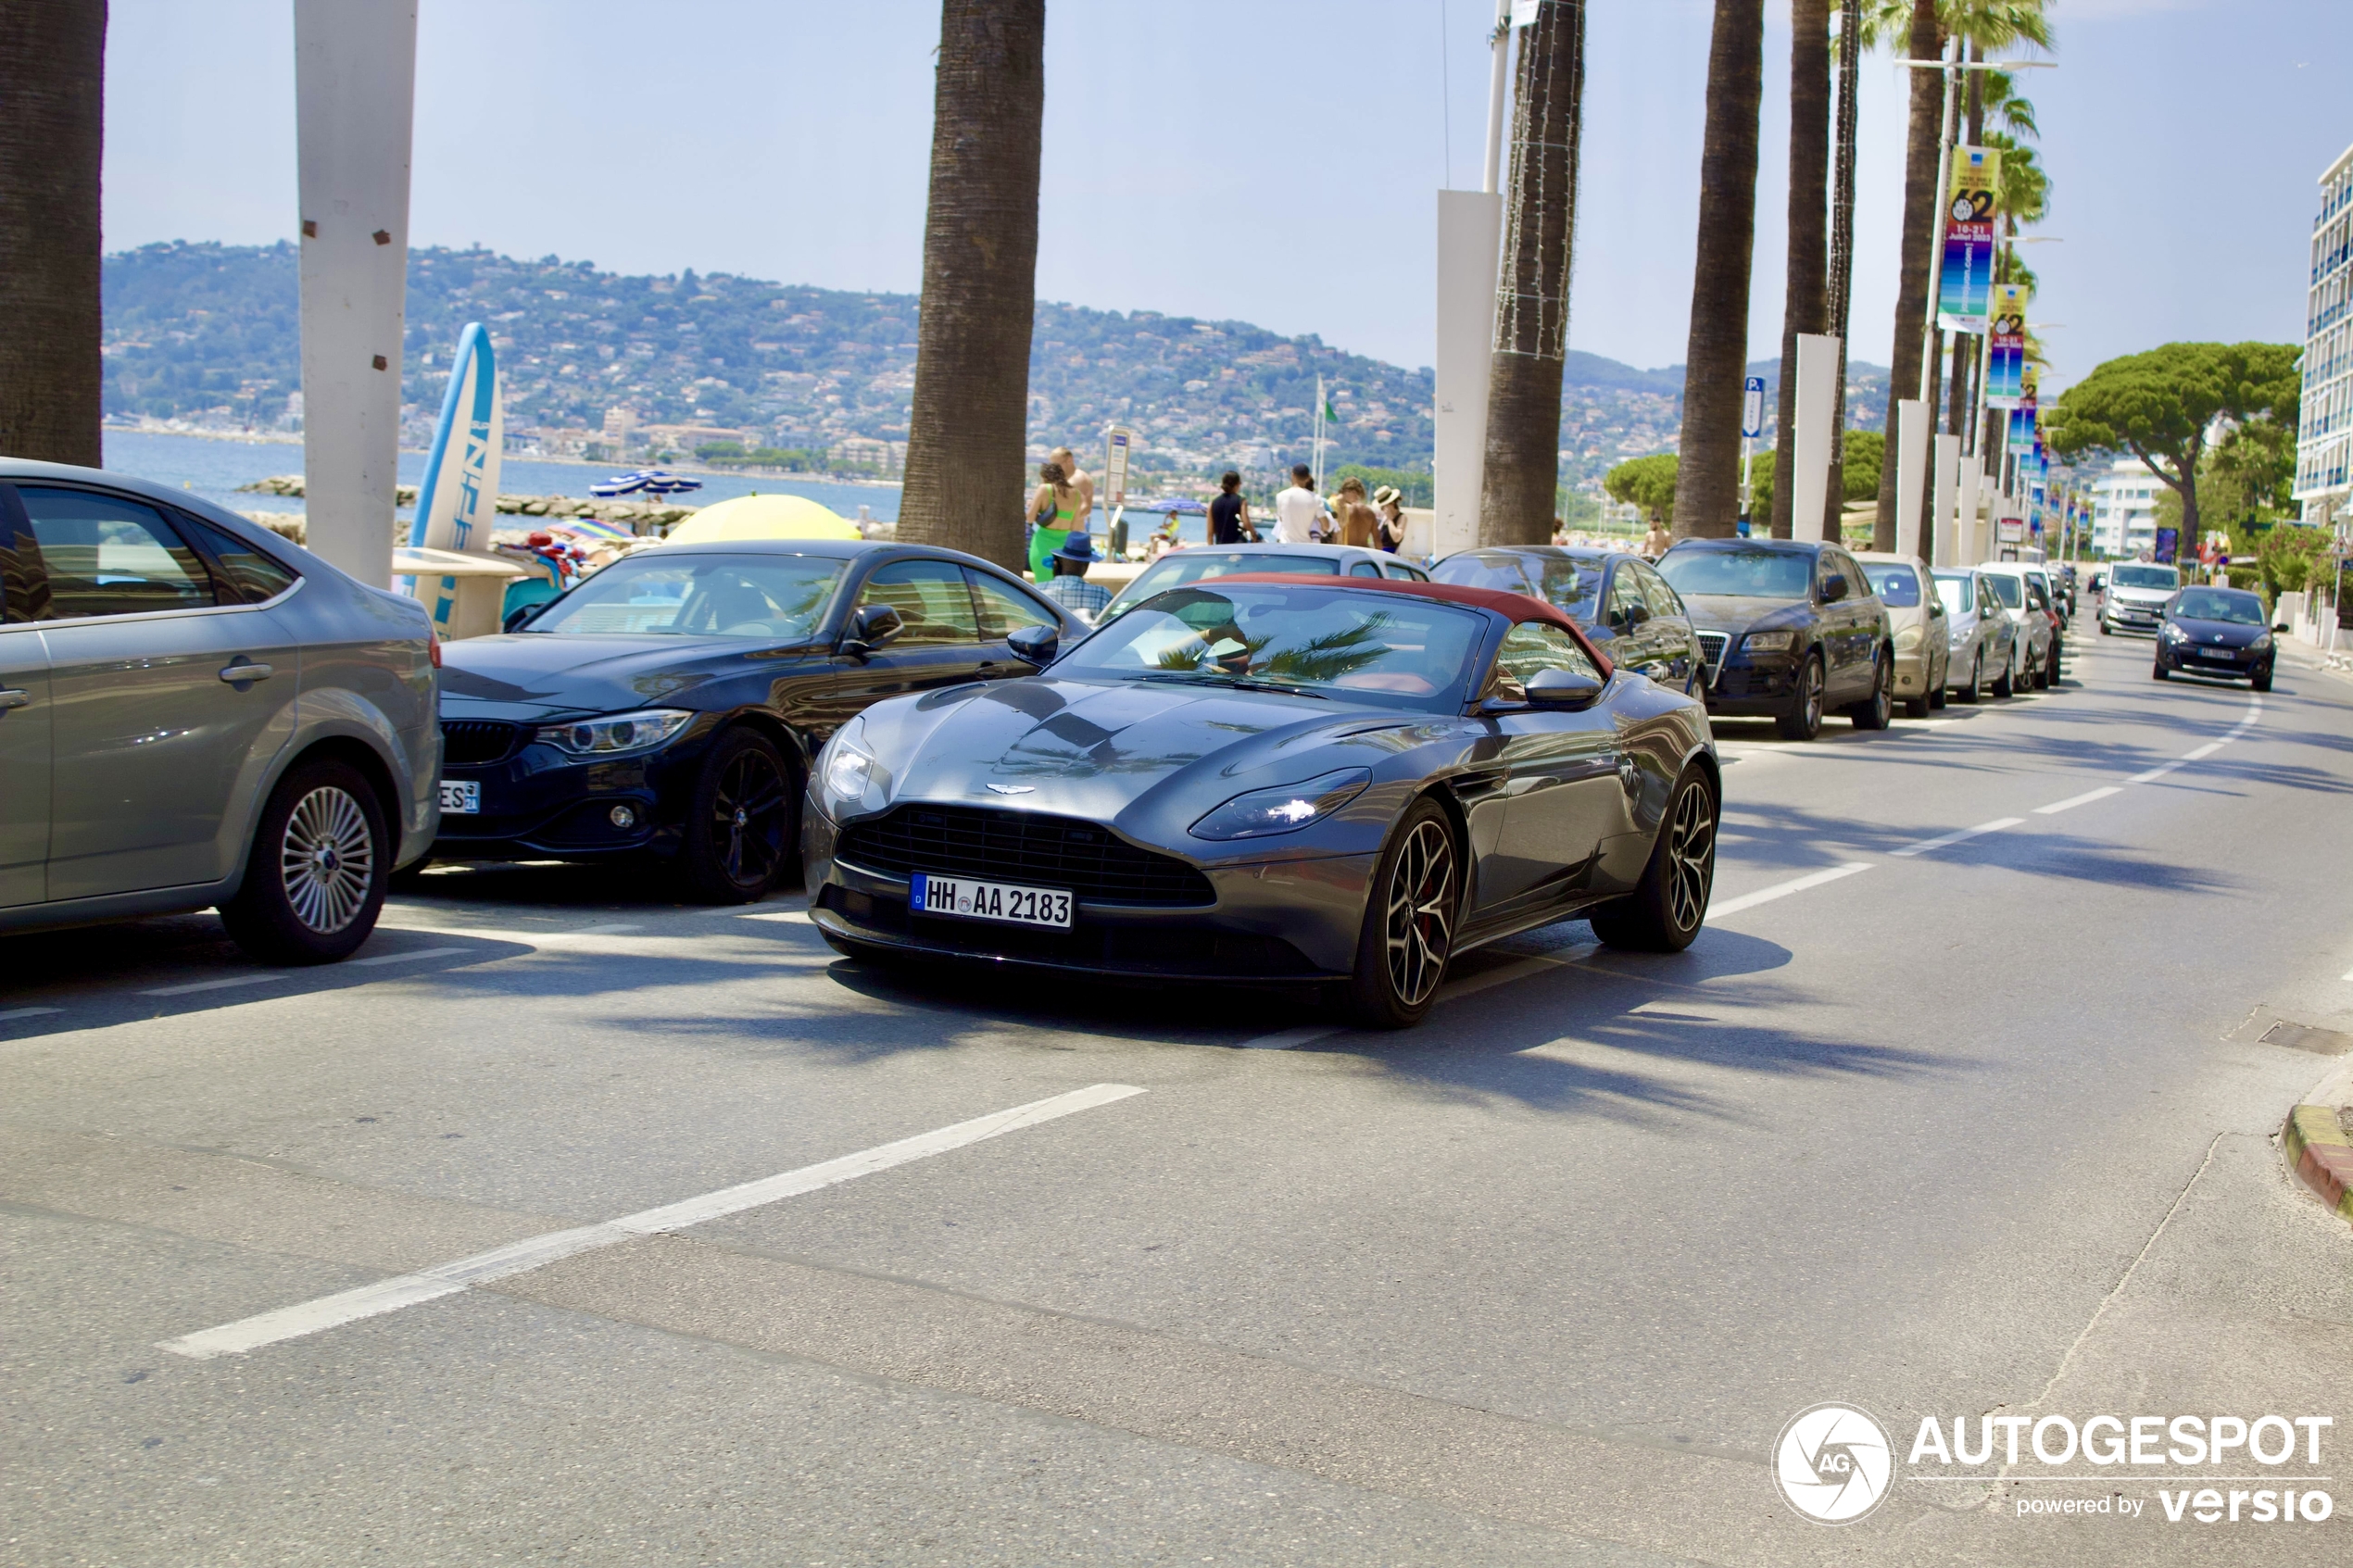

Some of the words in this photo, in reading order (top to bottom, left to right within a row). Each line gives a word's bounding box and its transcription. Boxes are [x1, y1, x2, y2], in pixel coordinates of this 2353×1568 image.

[1951, 189, 1994, 221] 62
[1957, 224, 1984, 234] 10-21
[1994, 314, 2023, 335] 62
[915, 895, 922, 904] D
[927, 880, 956, 910] HH
[973, 886, 1002, 916] AA
[1008, 890, 1069, 923] 2183
